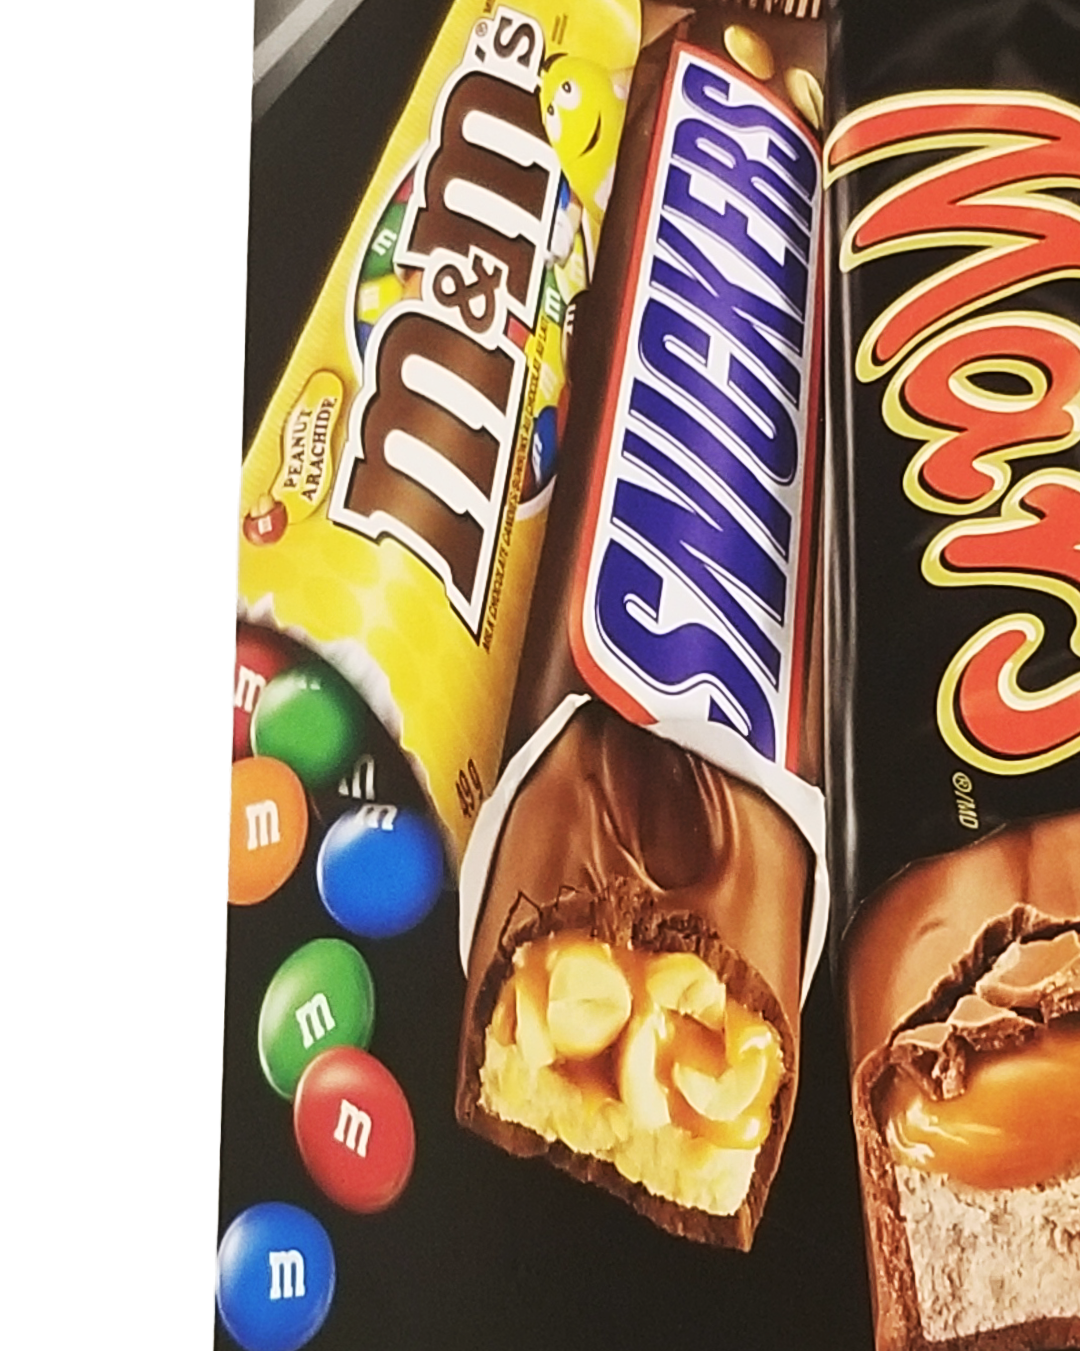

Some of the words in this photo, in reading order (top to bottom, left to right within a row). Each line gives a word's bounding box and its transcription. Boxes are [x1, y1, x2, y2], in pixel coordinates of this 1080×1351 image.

[284, 409, 312, 488] PEANUT
[302, 398, 337, 501] ARACHIDE
[598, 58, 824, 762] SNICKERS
